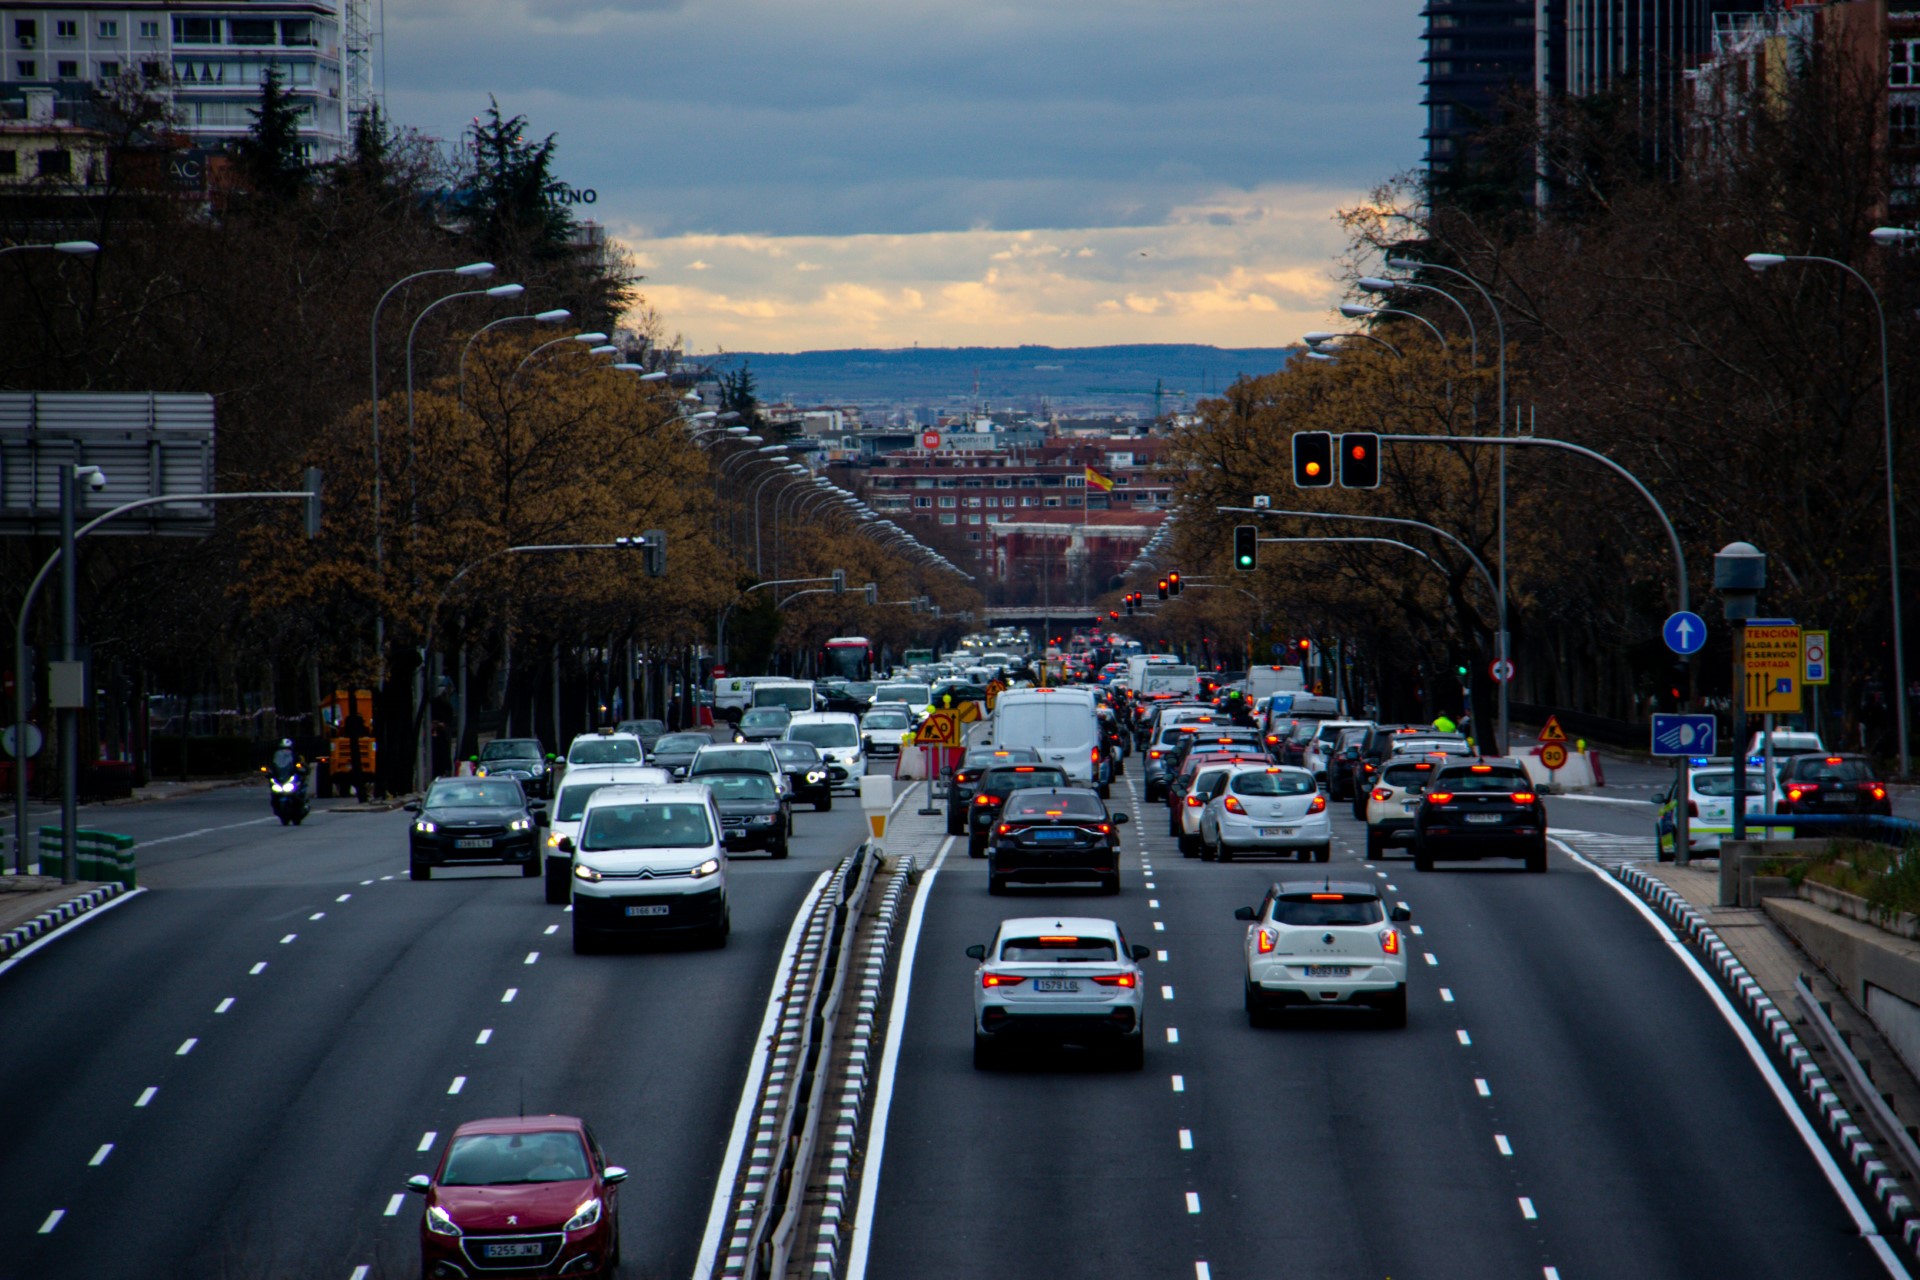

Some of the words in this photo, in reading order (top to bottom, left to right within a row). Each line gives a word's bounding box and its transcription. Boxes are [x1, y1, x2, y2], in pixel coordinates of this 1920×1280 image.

[169, 159, 200, 178] AC
[1747, 628, 1798, 639] TENCIÓN
[1746, 641, 1772, 649] ALIDA
[1782, 641, 1798, 649] VÍA
[1546, 751, 1561, 761] 30
[631, 906, 650, 915] 3166
[1041, 980, 1062, 990] 1579
[490, 1245, 517, 1256] 5255
[520, 1244, 539, 1255] JMZ
